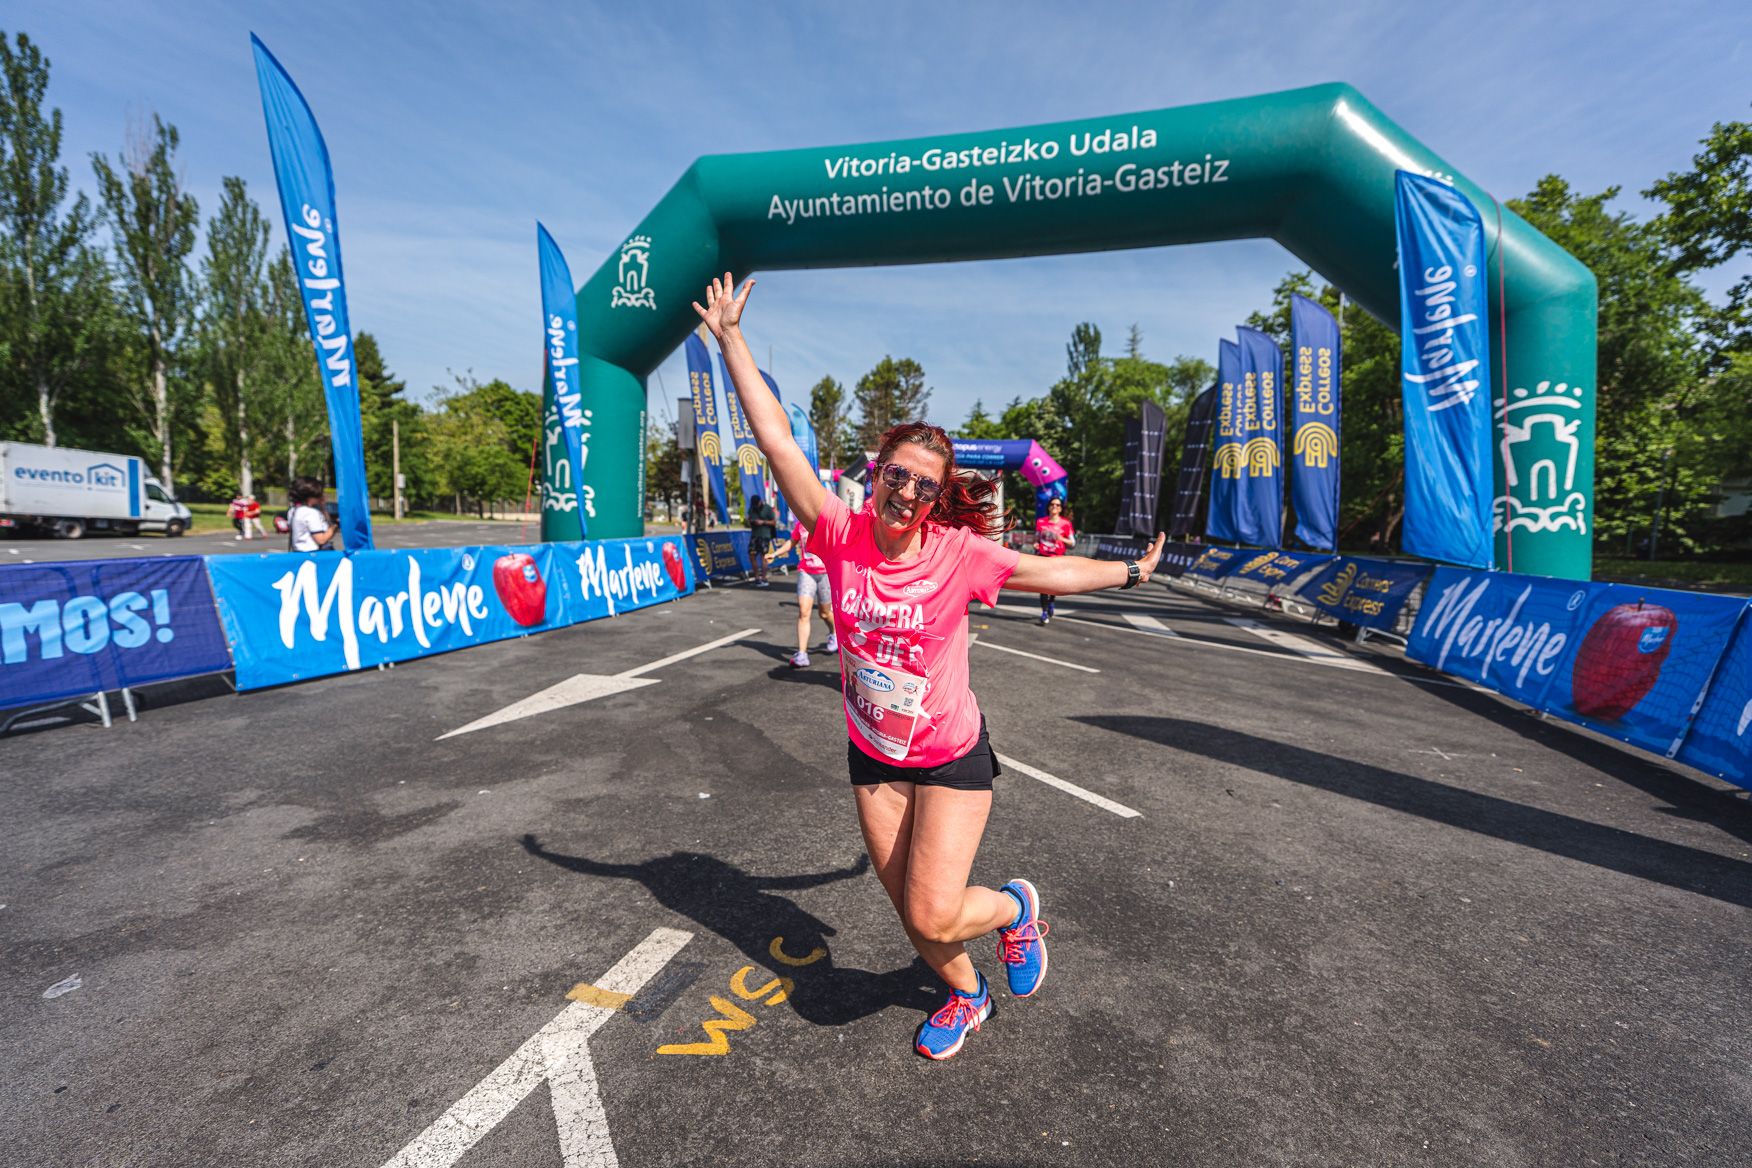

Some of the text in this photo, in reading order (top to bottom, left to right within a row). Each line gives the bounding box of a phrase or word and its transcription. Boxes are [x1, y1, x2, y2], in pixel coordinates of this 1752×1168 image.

[824, 125, 1158, 179] Vitoria-Gasteizko Udala
[767, 154, 1231, 225] Ayuntamiento de Vitoria-Gasteiz
[14, 467, 118, 486] evento kit
[271, 554, 488, 669] Marlene
[575, 544, 664, 616] Marlene
[1422, 577, 1567, 688] Marlene
